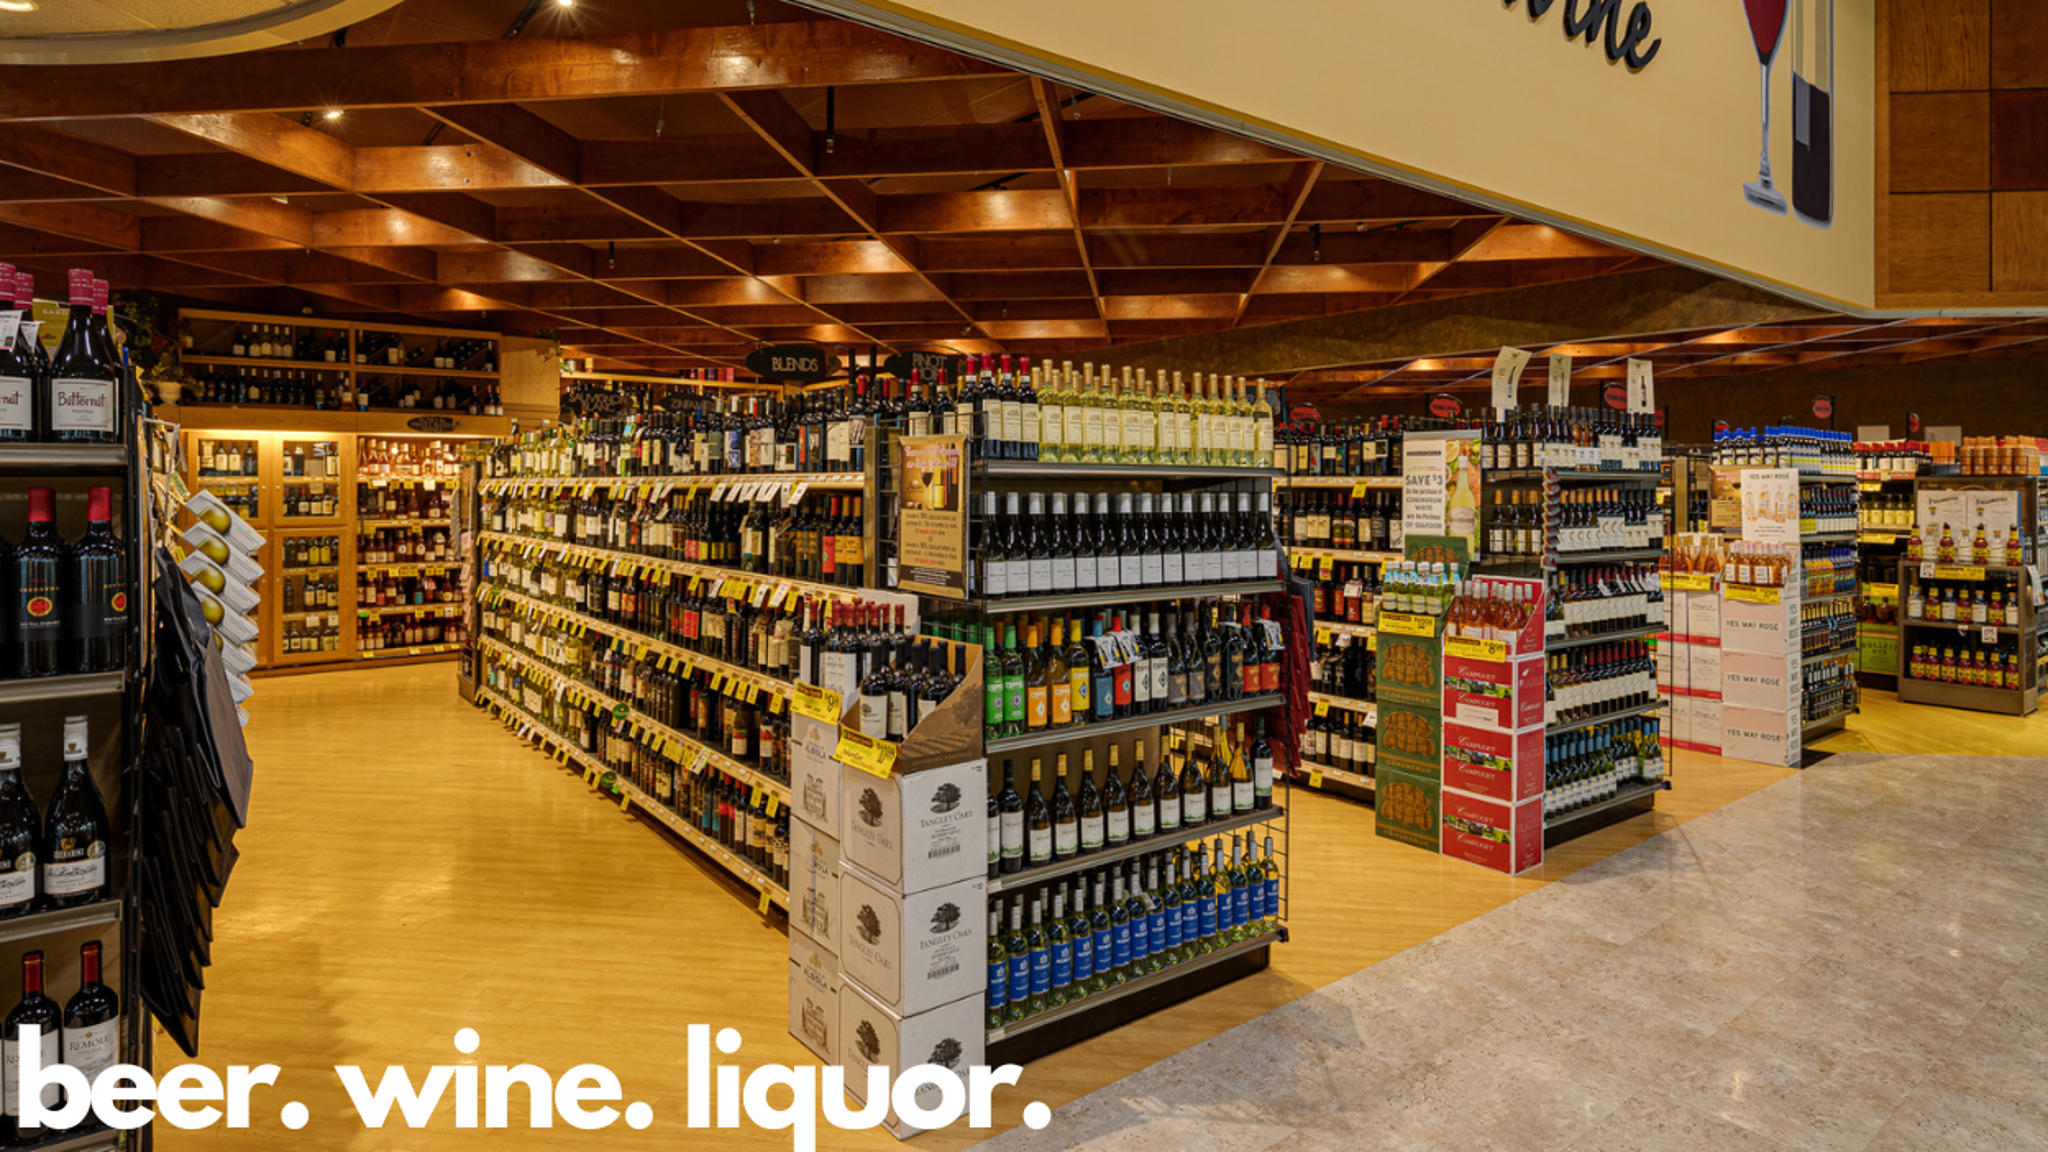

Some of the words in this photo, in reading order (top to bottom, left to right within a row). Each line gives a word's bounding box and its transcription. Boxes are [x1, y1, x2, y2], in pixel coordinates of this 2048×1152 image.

[1504, 0, 1661, 69] ine
[772, 357, 819, 372] BLENDS
[912, 353, 947, 370] PINOT
[58, 391, 108, 407] Butternut
[582, 401, 616, 412] BLANC
[1405, 475, 1431, 486] SAVE
[1433, 474, 1443, 486] $3
[1726, 619, 1740, 628] YES
[1741, 620, 1757, 628] WAY
[1861, 642, 1898, 651] BULLEIT
[1727, 673, 1741, 682] YES
[1742, 674, 1759, 684] WAY
[1727, 728, 1741, 737] YES
[920, 815, 952, 828] TANGLEY
[954, 810, 973, 822] OAKS
[851, 819, 876, 843] TANGLEY
[876, 833, 893, 851] OAKS
[919, 934, 951, 950] TANGLEY
[953, 929, 972, 941] OAKS
[849, 933, 875, 960] TANGLEY
[875, 951, 892, 971] OAKS
[70, 1035, 110, 1051] REMOLE
